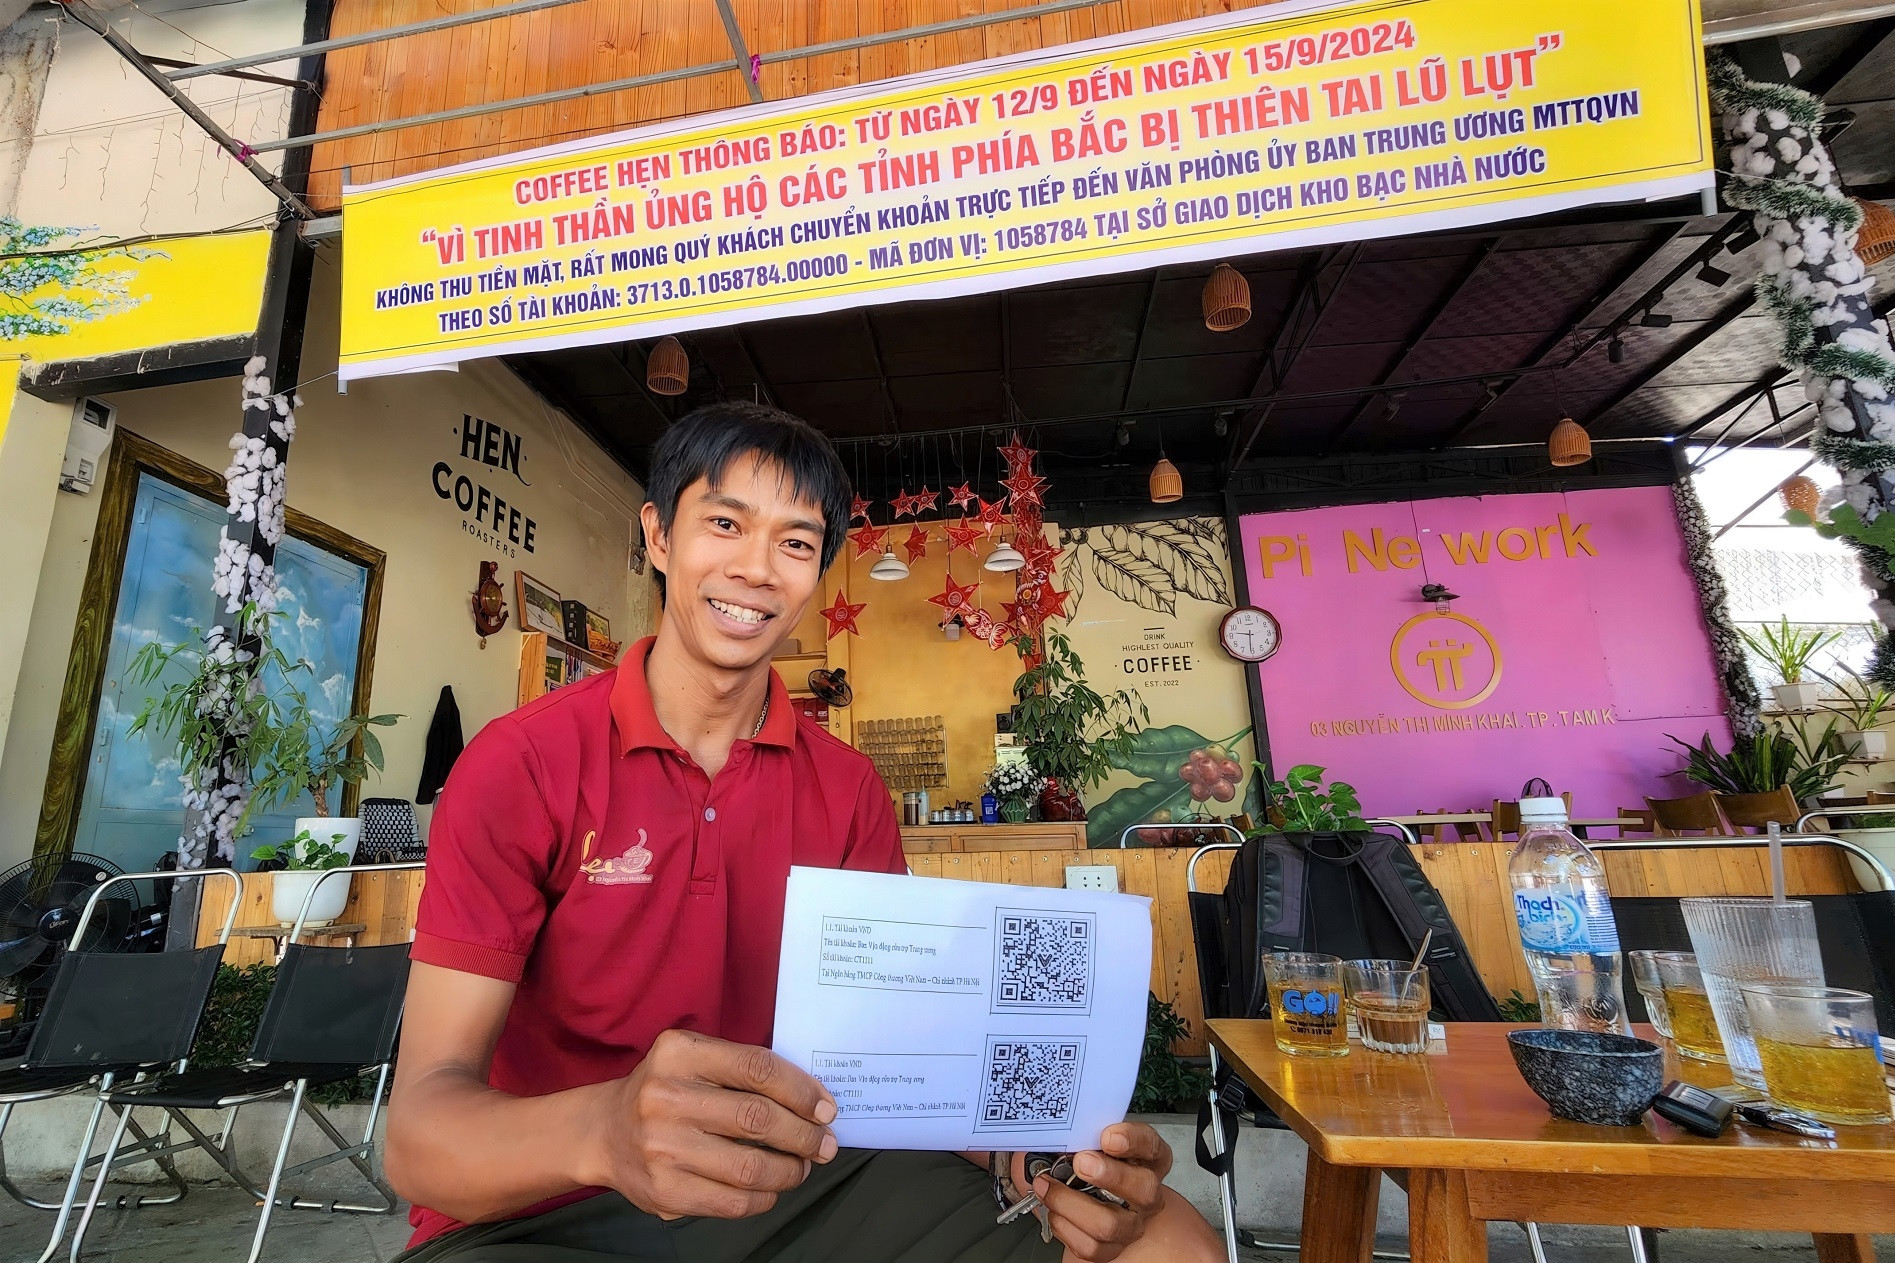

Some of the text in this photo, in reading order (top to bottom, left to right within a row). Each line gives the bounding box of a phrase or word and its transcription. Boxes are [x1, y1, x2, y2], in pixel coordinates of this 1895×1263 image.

[516, 20, 1415, 204] COFFEE HẸN THÔNG BÁO: TỪ NGÀY 12/9 ĐẾN NGÀY 15/9/2024
[423, 34, 1560, 264] “VÌ TINH THẦN ỦNG HỘ CÁC TỈNH PHÍA BẮC BỊ THIÊN TAI LŨ LỤT”
[377, 91, 1638, 309] KHÔNG THU TIỀN MẶT, RẤT MONG QUÝ KHÁCH CHUYỂN KHOẢN TRỰC TIẾP ĐẾN VĂN PHÒNG ỦY BAN TRUNG ƯƠNG MTTQVN
[439, 309, 482, 332] THEO
[489, 300, 511, 325] SỐ
[518, 296, 545, 321] TÀI
[553, 284, 620, 316] KHOẢN:
[627, 254, 847, 305] 3713.0.1058784.00000
[869, 241, 903, 270] MÃ
[909, 237, 953, 264] ĐƠN
[959, 233, 986, 259] VỊ:
[994, 218, 1087, 251] 1058784
[1094, 210, 1129, 239] TẠI
[1137, 197, 1166, 230] SỞ
[1175, 196, 1228, 224] GIAO
[1237, 186, 1292, 219] DỊCH
[1300, 178, 1348, 206] KHO
[1357, 169, 1405, 201] BẠC
[1415, 156, 1467, 190] NHÀ
[1475, 146, 1545, 181] NƯỚC
[432, 462, 537, 554] COFFEE
[462, 520, 516, 558] ROASTERS
[1258, 533, 1314, 579] Pi
[1144, 633, 1166, 641] DRINK
[1163, 641, 1194, 650] QUALITY
[1123, 656, 1193, 674] COFFEE
[1310, 721, 1328, 737] 03
[1433, 713, 1473, 732] MINH
[1557, 709, 1599, 726] TAM
